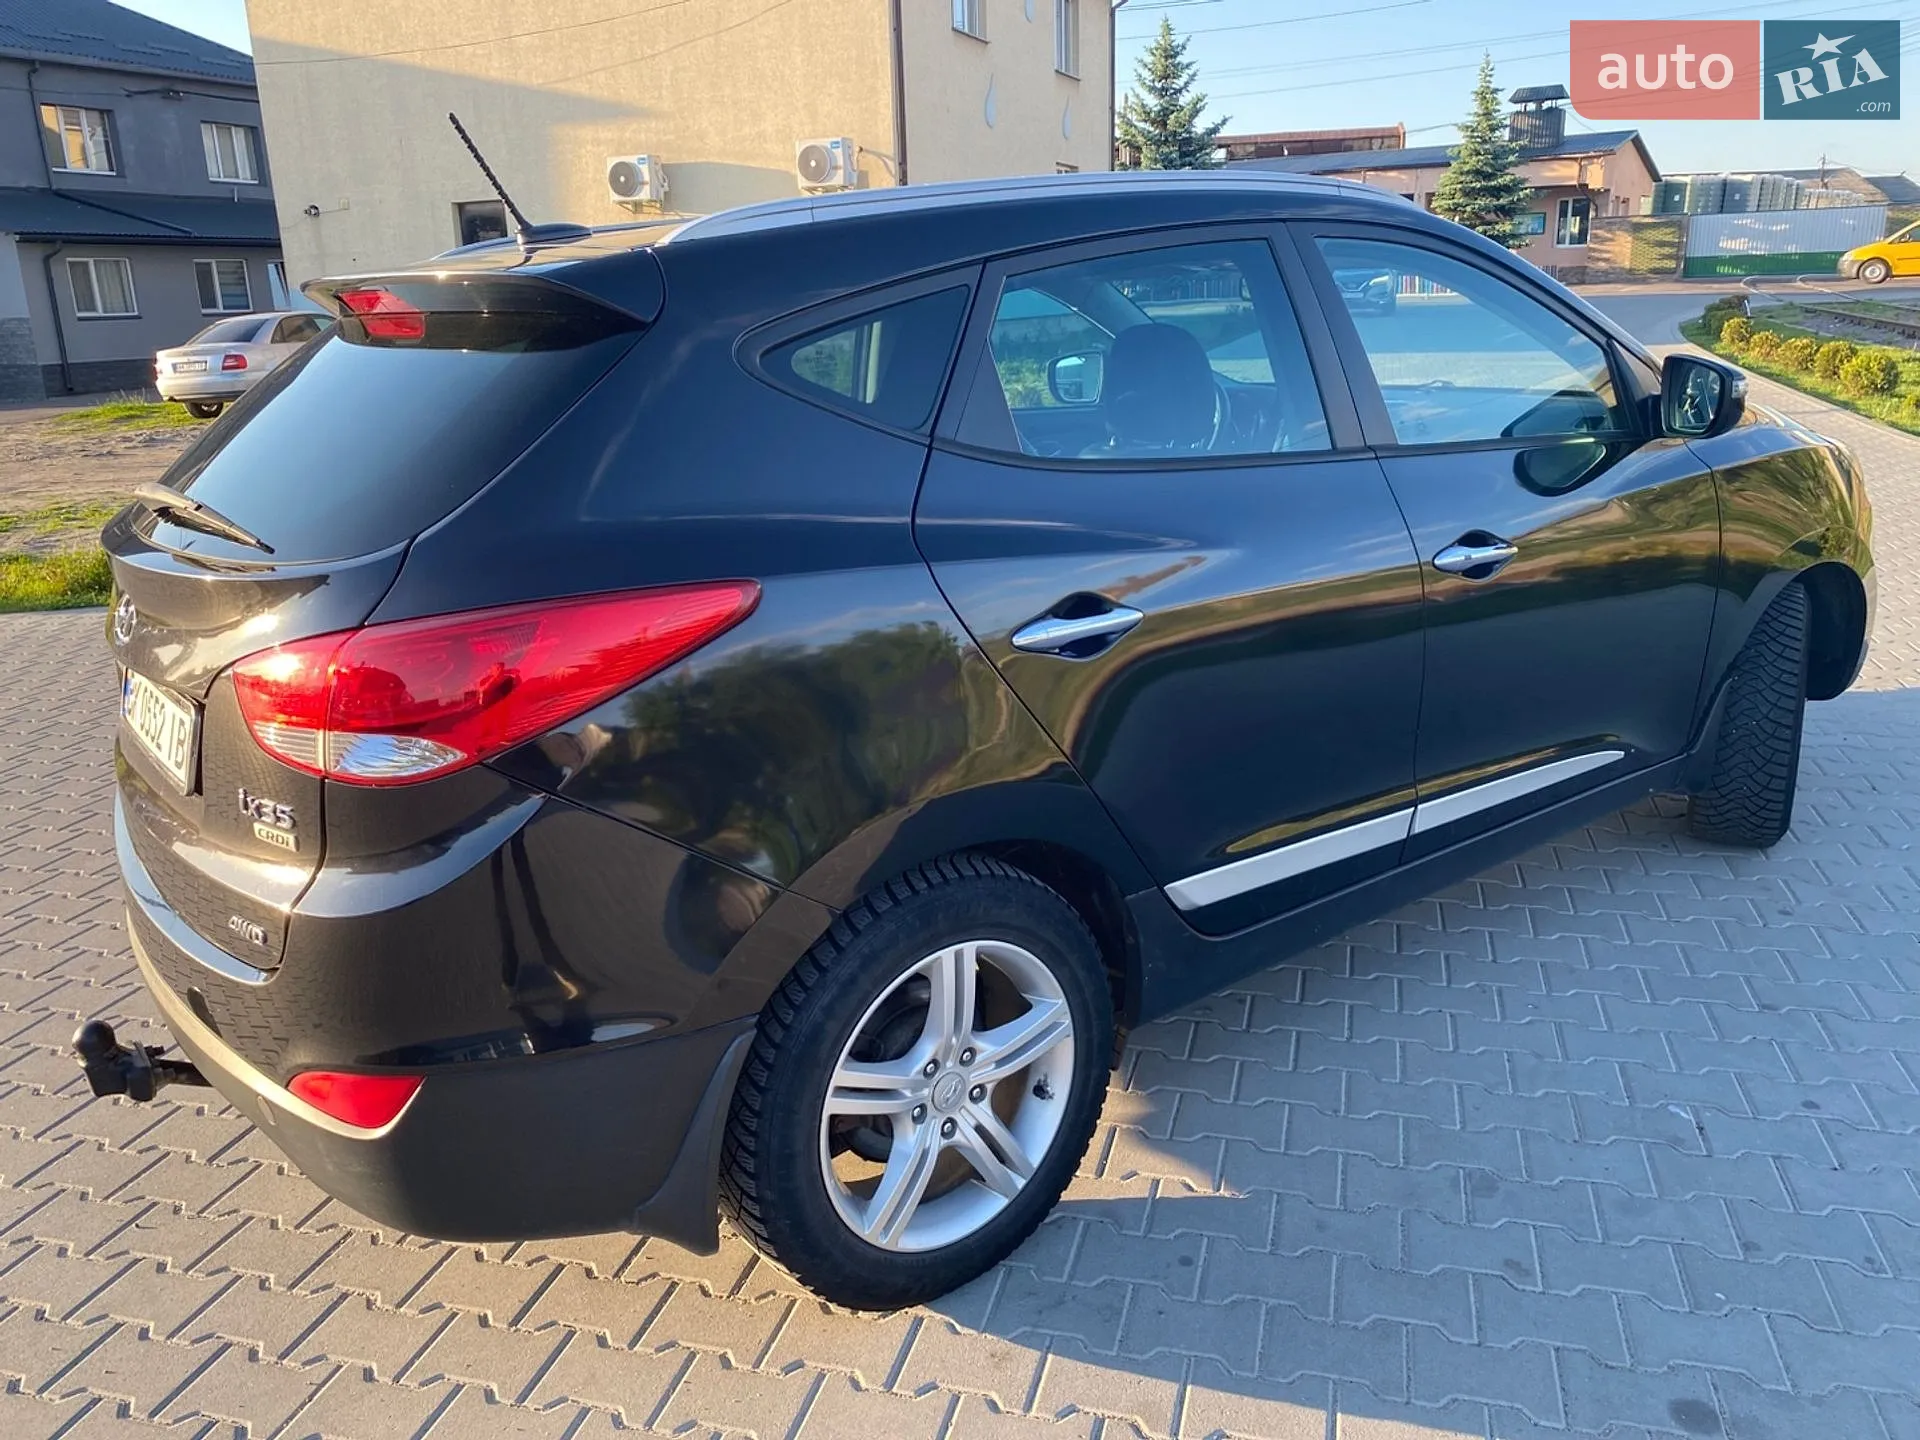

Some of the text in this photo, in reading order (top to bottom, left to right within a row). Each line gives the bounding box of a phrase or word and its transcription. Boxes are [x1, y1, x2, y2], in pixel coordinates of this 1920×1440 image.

[238, 787, 296, 830] ix35
[258, 826, 290, 848] CRDi
[228, 913, 265, 946] 4WD
